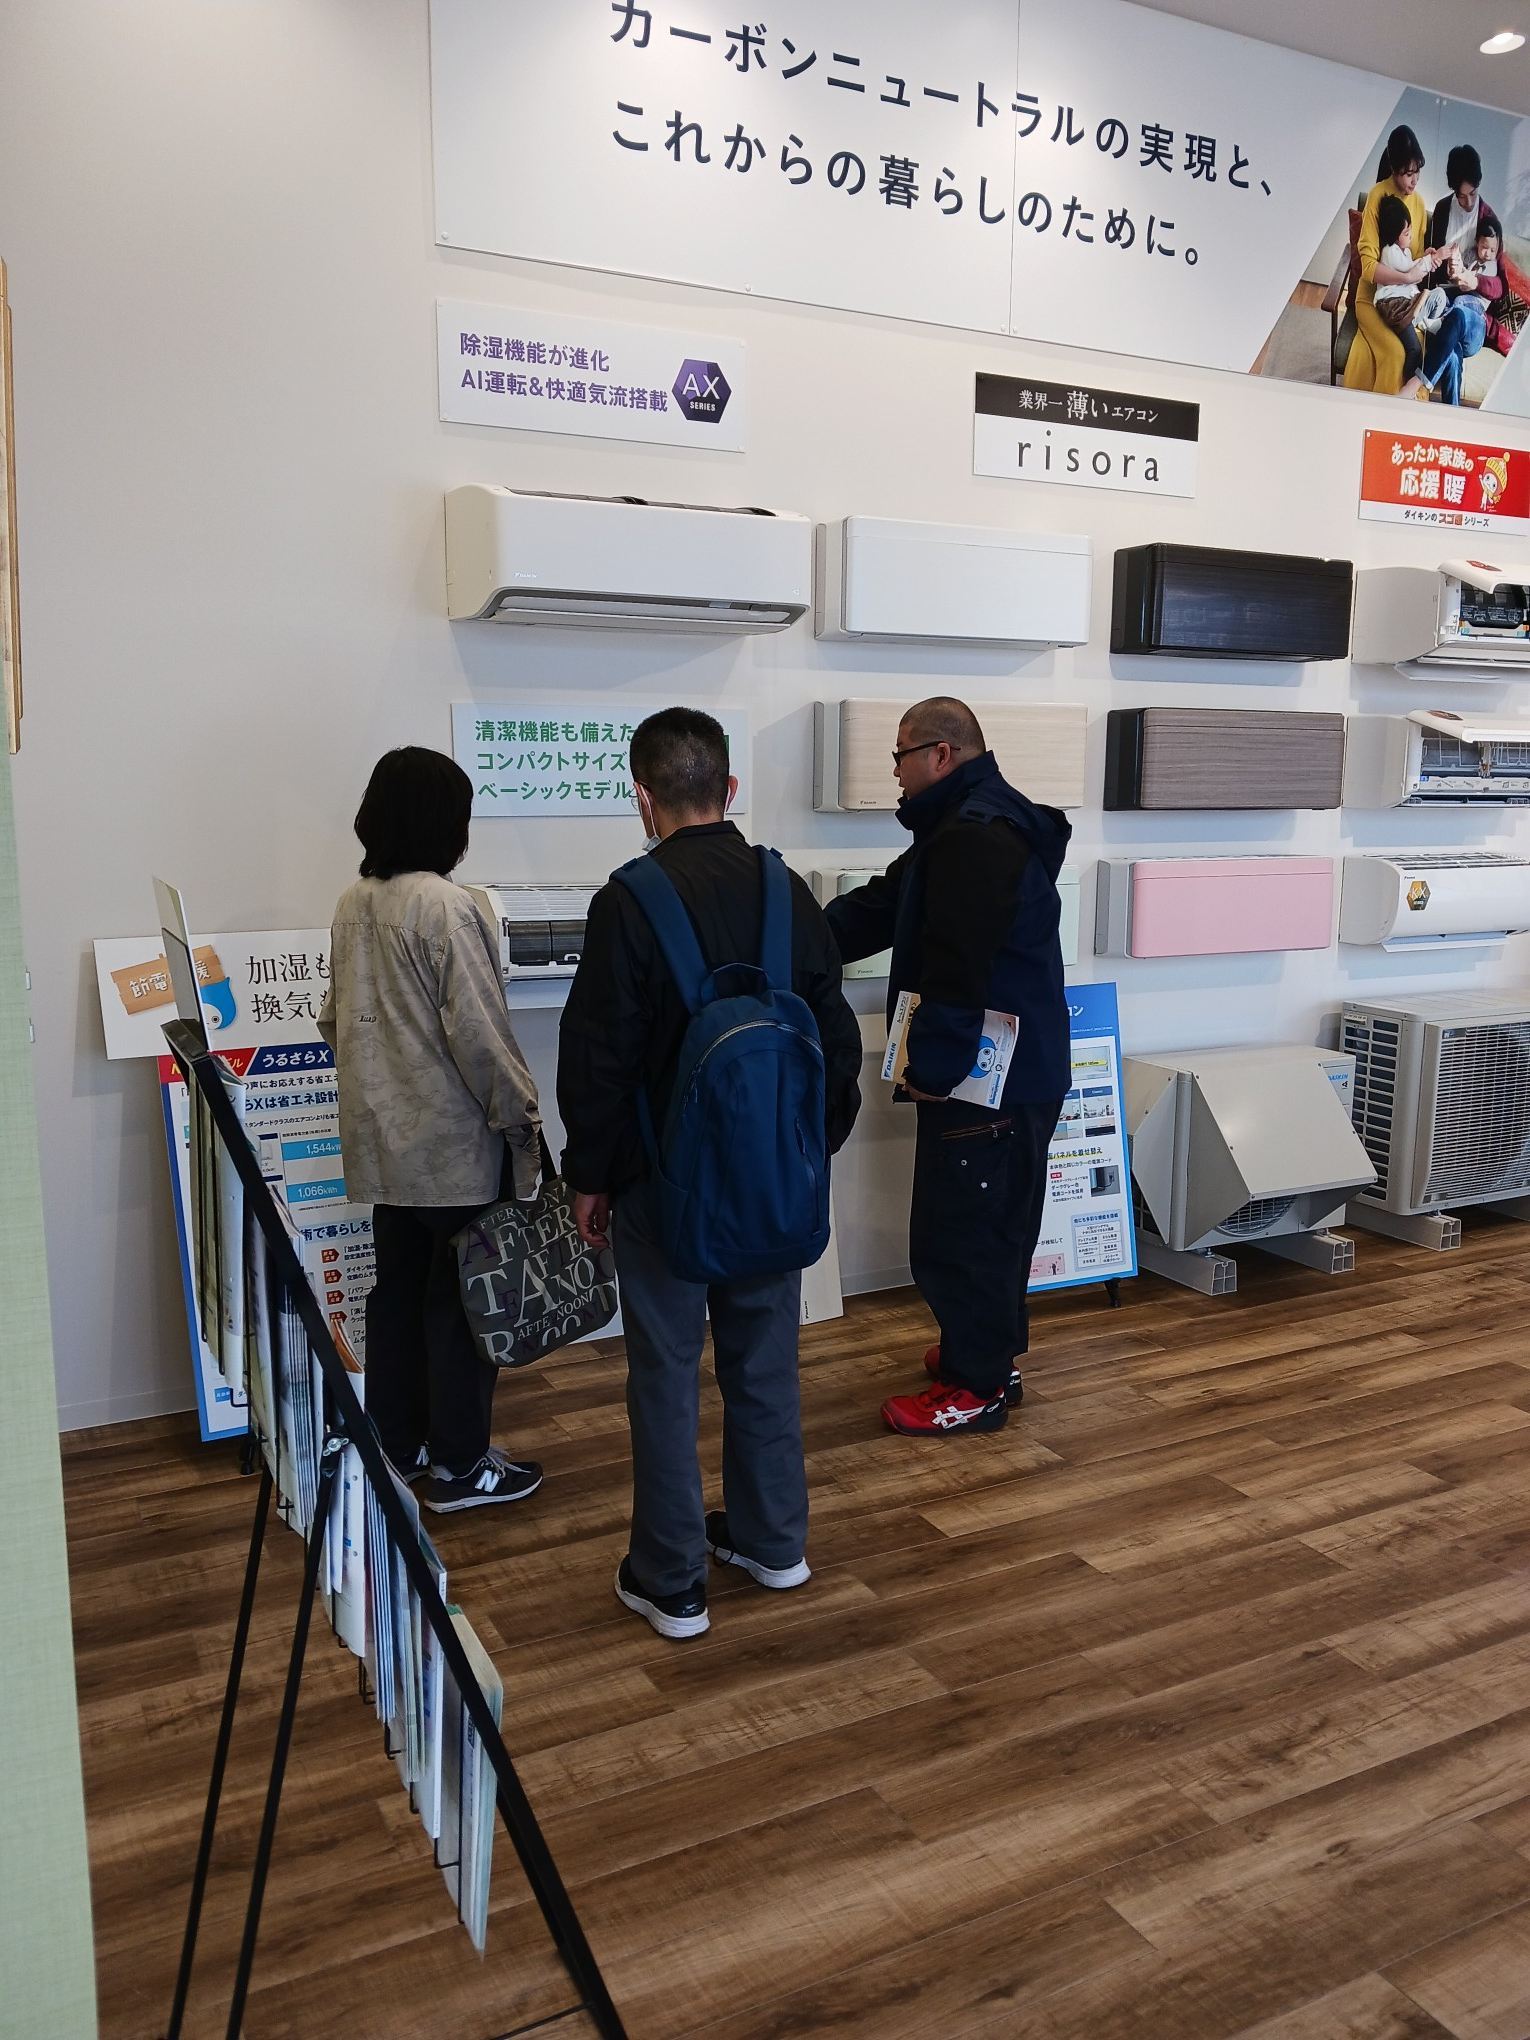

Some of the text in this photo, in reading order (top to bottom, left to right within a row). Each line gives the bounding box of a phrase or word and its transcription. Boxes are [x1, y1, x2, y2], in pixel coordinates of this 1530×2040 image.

[611, 0, 1273, 196] カーボンニュートラルの実現と、
[612, 101, 1199, 266] これからの暮らしのために。
[460, 332, 610, 372] 除湿機能が進化
[461, 369, 668, 412] AI運転&快適気流搭載
[681, 373, 720, 400] AX
[689, 401, 717, 412] SERIES
[1018, 429, 1159, 481] risora
[1391, 441, 1474, 472] あったか家族の
[475, 720, 634, 742] 清潔機能も備えた
[477, 751, 628, 772] コンパクトサイズ
[477, 780, 630, 800] ベーシックモデル
[245, 953, 331, 984] 加湿も
[262, 1050, 329, 1067] うるさらX
[886, 1042, 897, 1072] DAIKIN
[475, 1469, 499, 1493] N
